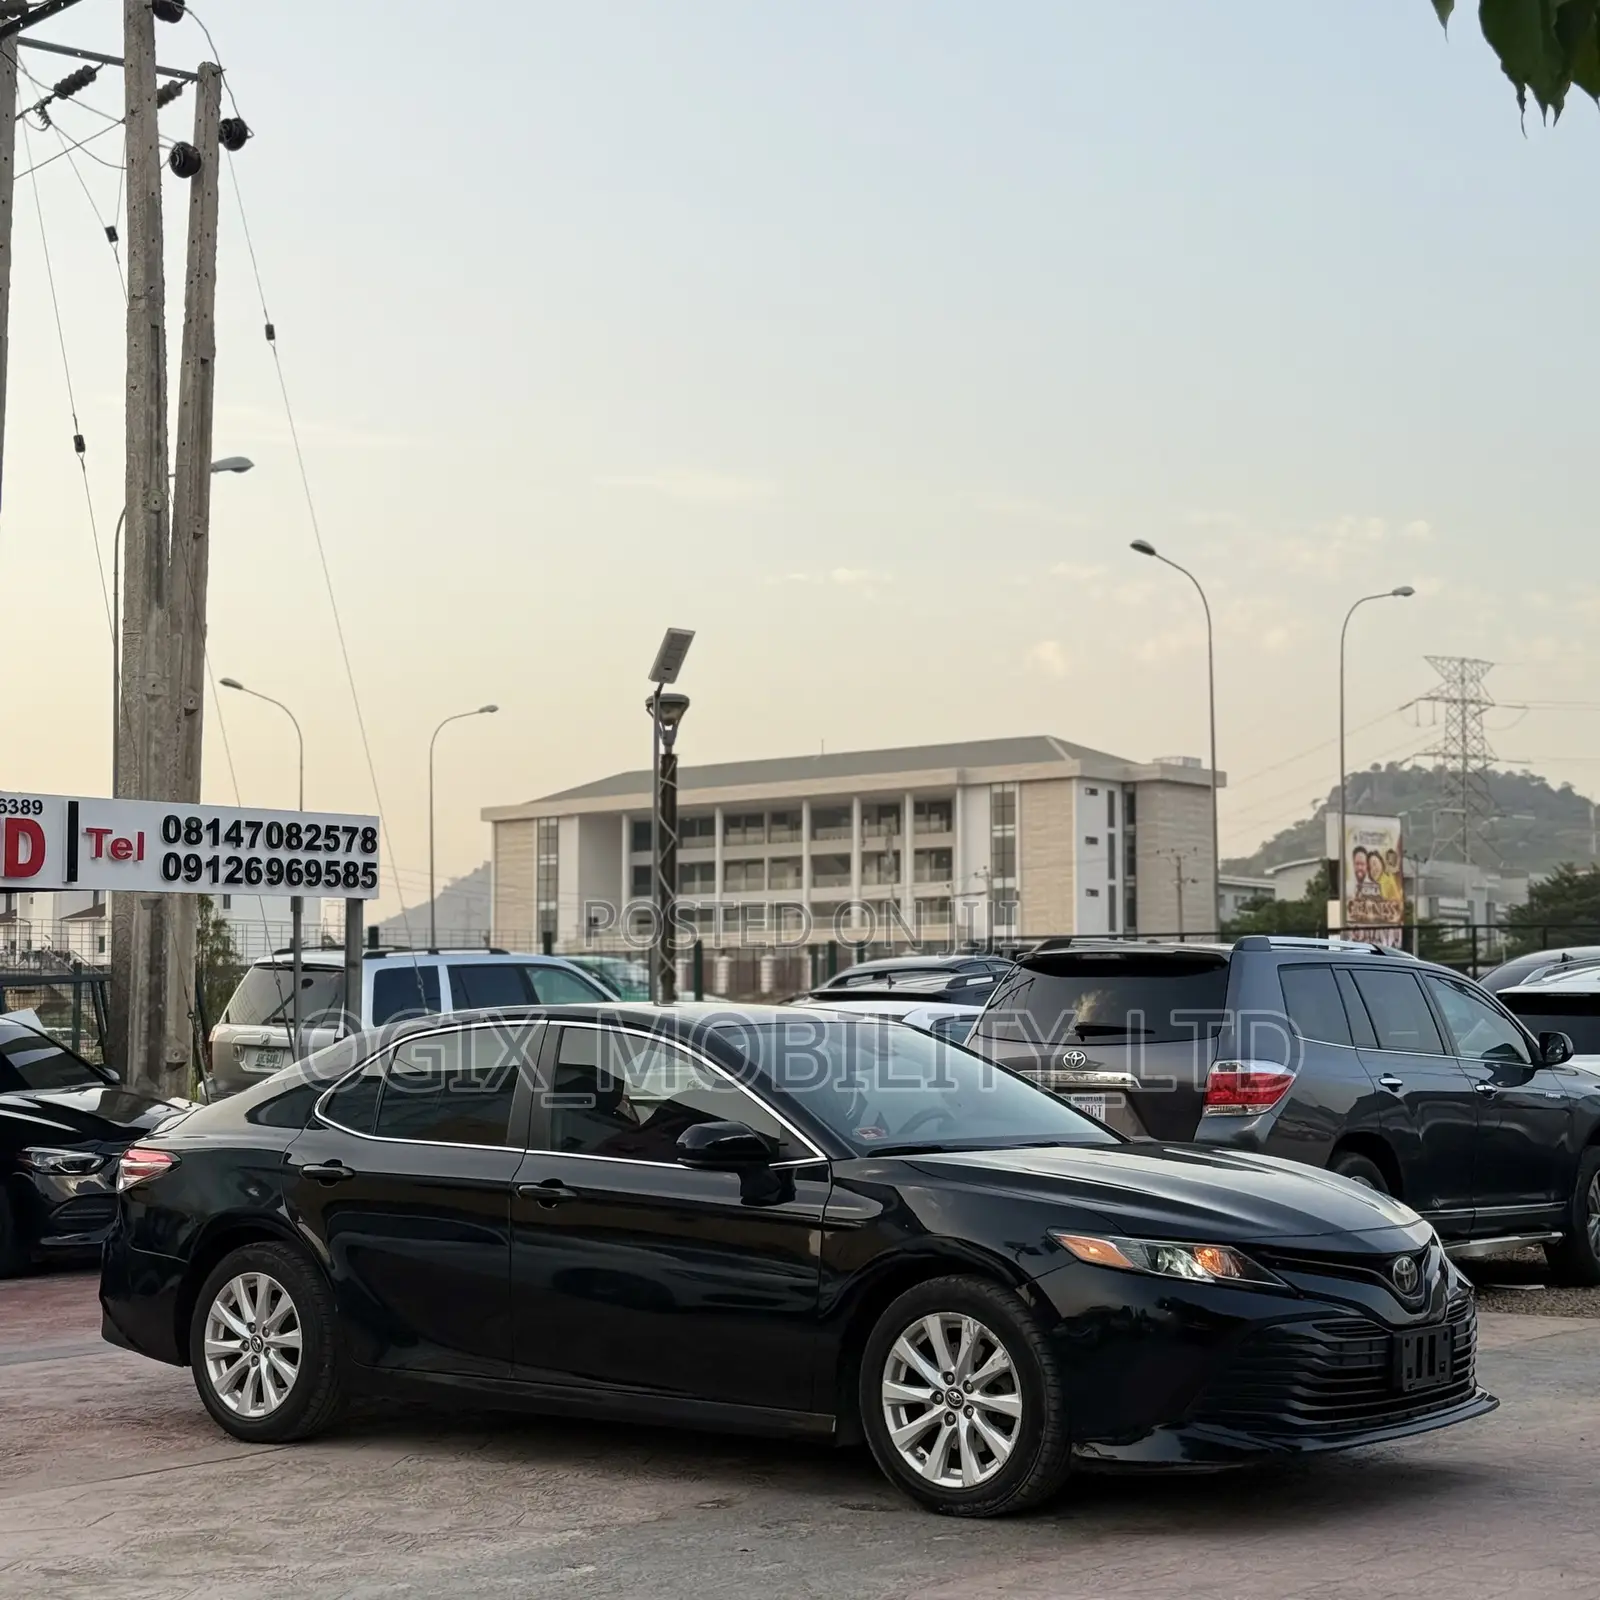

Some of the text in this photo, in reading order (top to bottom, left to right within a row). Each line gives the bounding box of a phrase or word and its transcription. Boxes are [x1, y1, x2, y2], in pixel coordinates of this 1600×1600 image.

[85, 827, 144, 861] Tel
[162, 814, 378, 854] 08147082578
[162, 851, 378, 889] 09126969585
